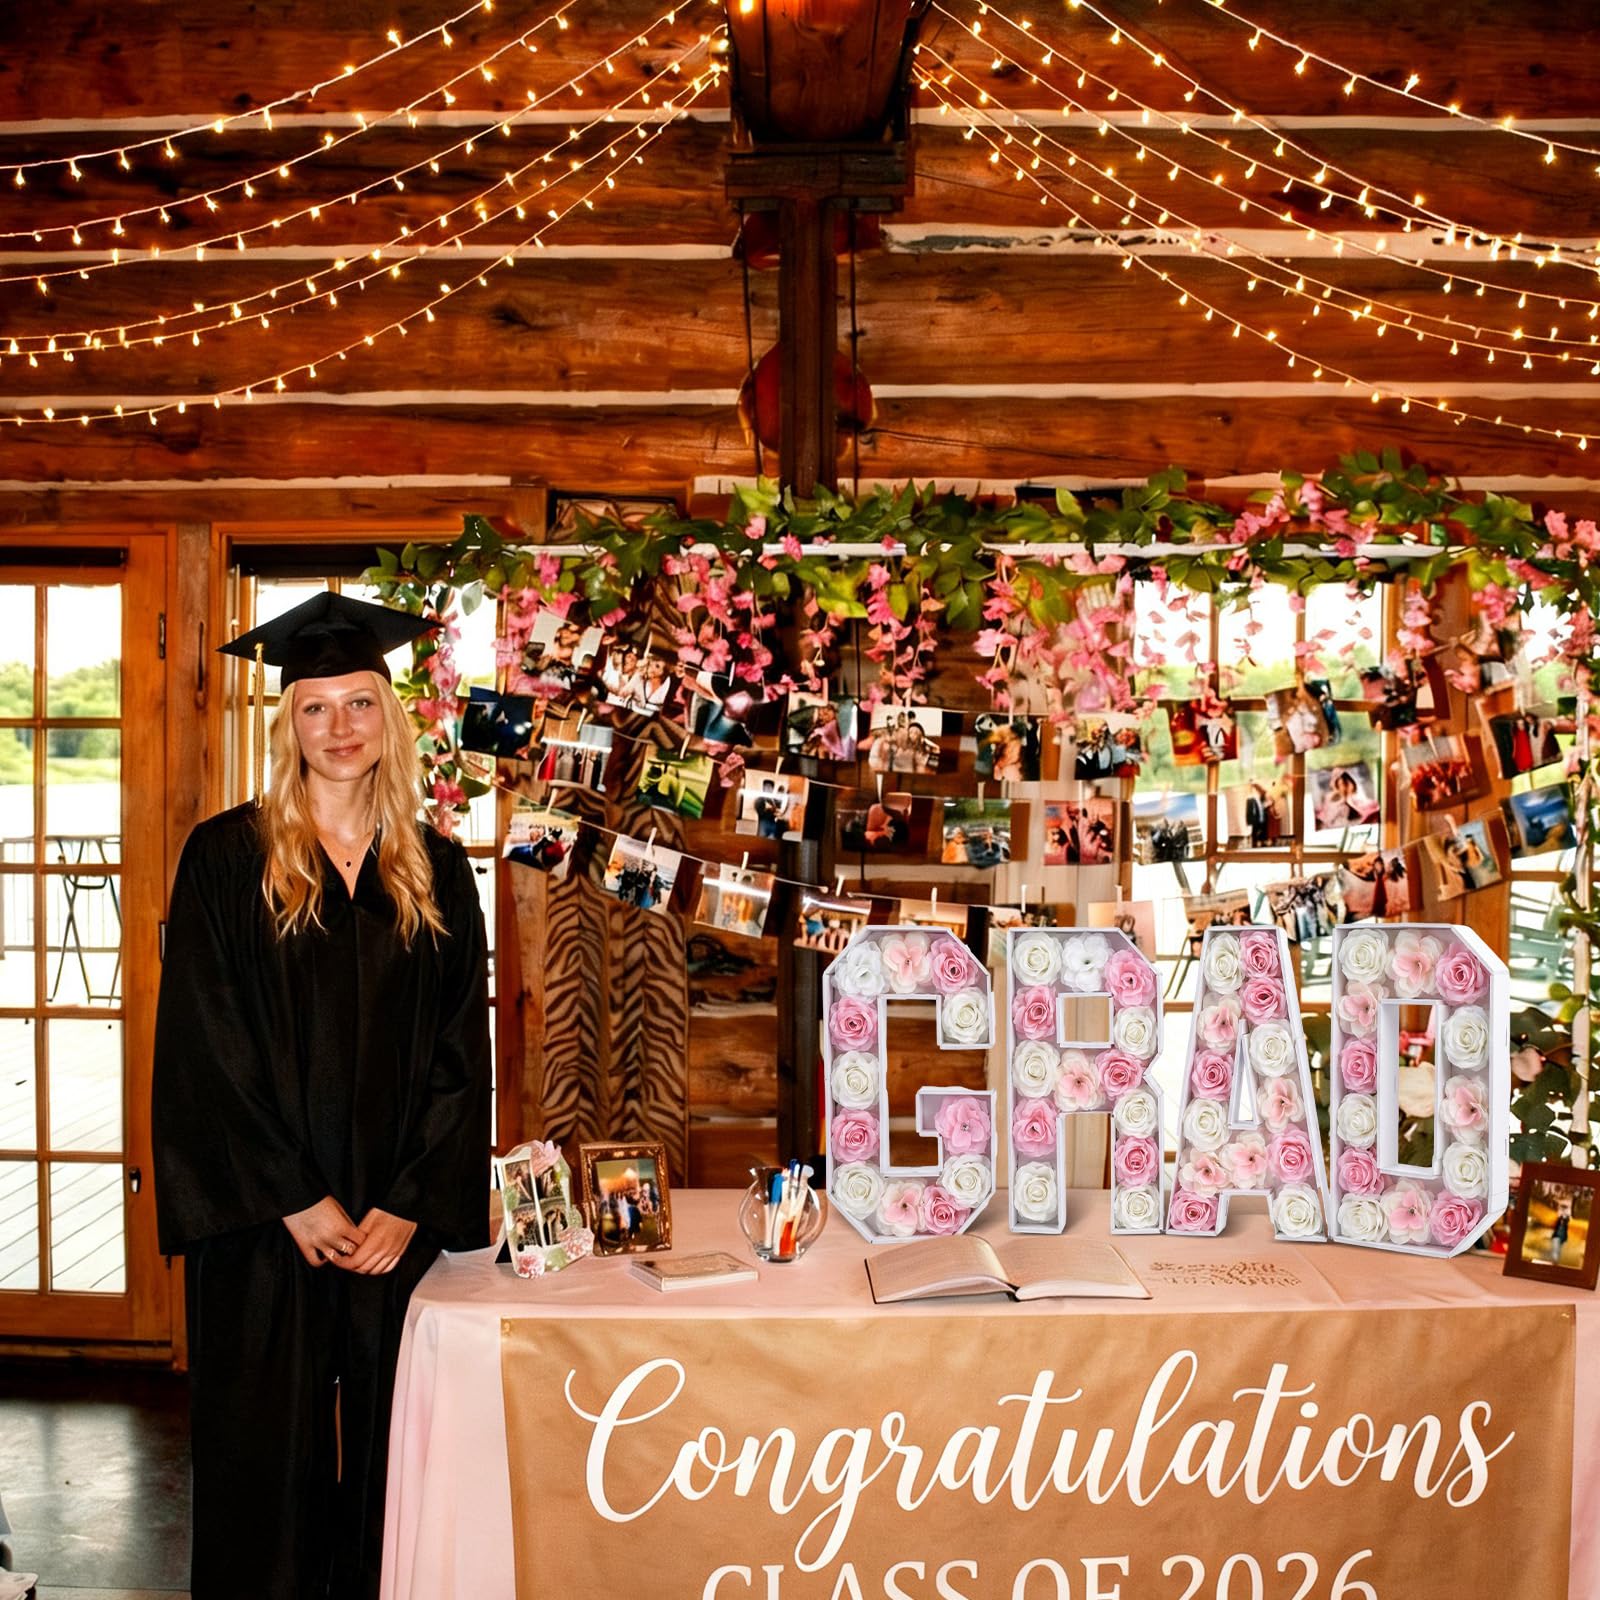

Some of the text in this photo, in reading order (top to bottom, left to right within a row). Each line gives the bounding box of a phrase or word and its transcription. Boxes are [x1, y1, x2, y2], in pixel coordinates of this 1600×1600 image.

[822, 924, 1510, 1258] GRAD
[564, 1349, 1516, 1572] Congratulations
[1011, 1554, 1129, 1600] OF
[1161, 1549, 1378, 1600] 2026
